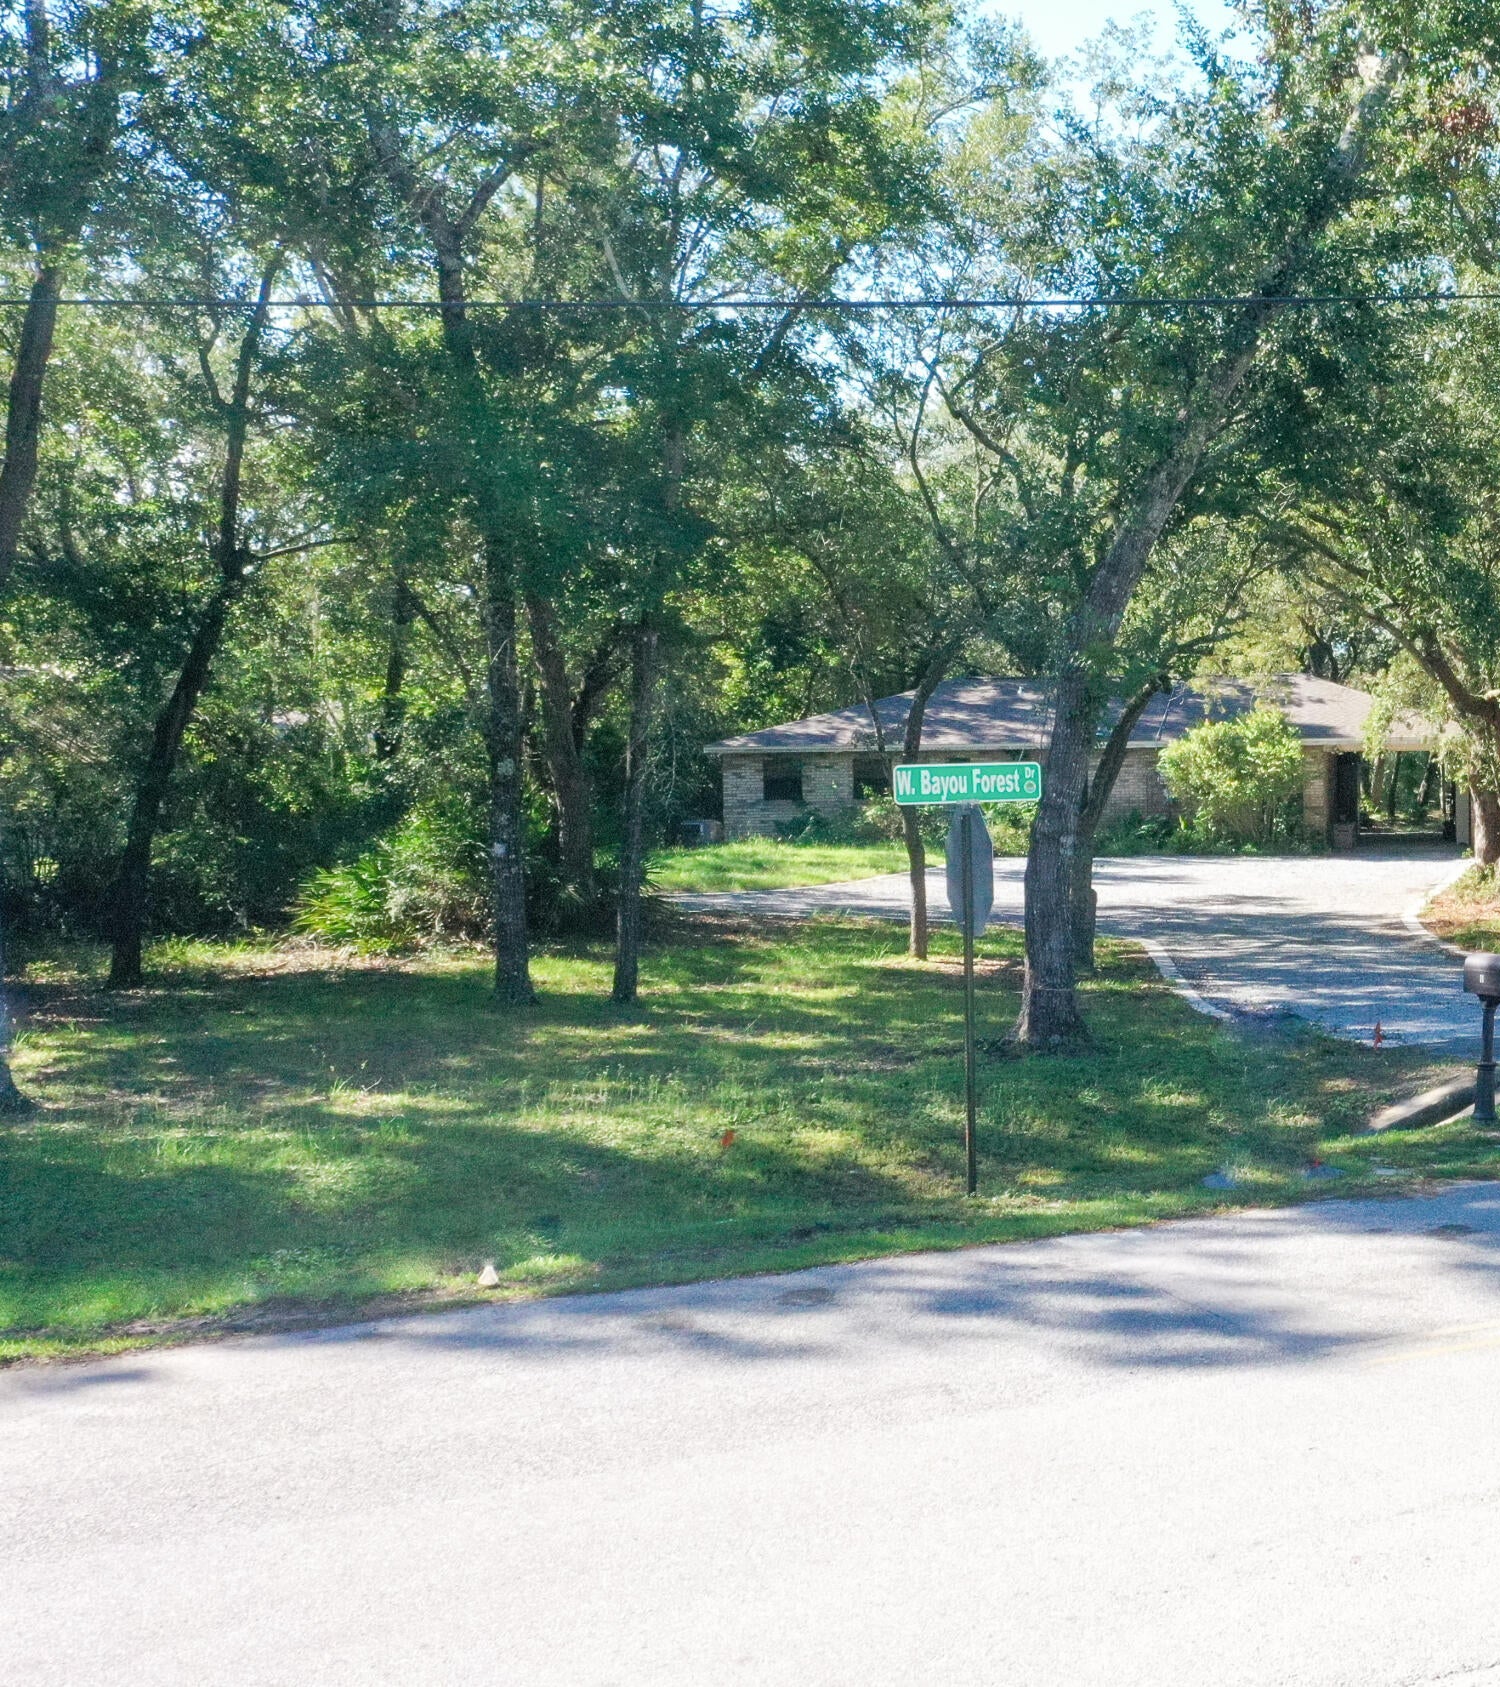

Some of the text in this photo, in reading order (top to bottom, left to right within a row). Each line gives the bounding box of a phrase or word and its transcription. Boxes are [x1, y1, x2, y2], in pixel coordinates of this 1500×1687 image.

[896, 766, 1035, 801] W. Bayou Forest Dr
